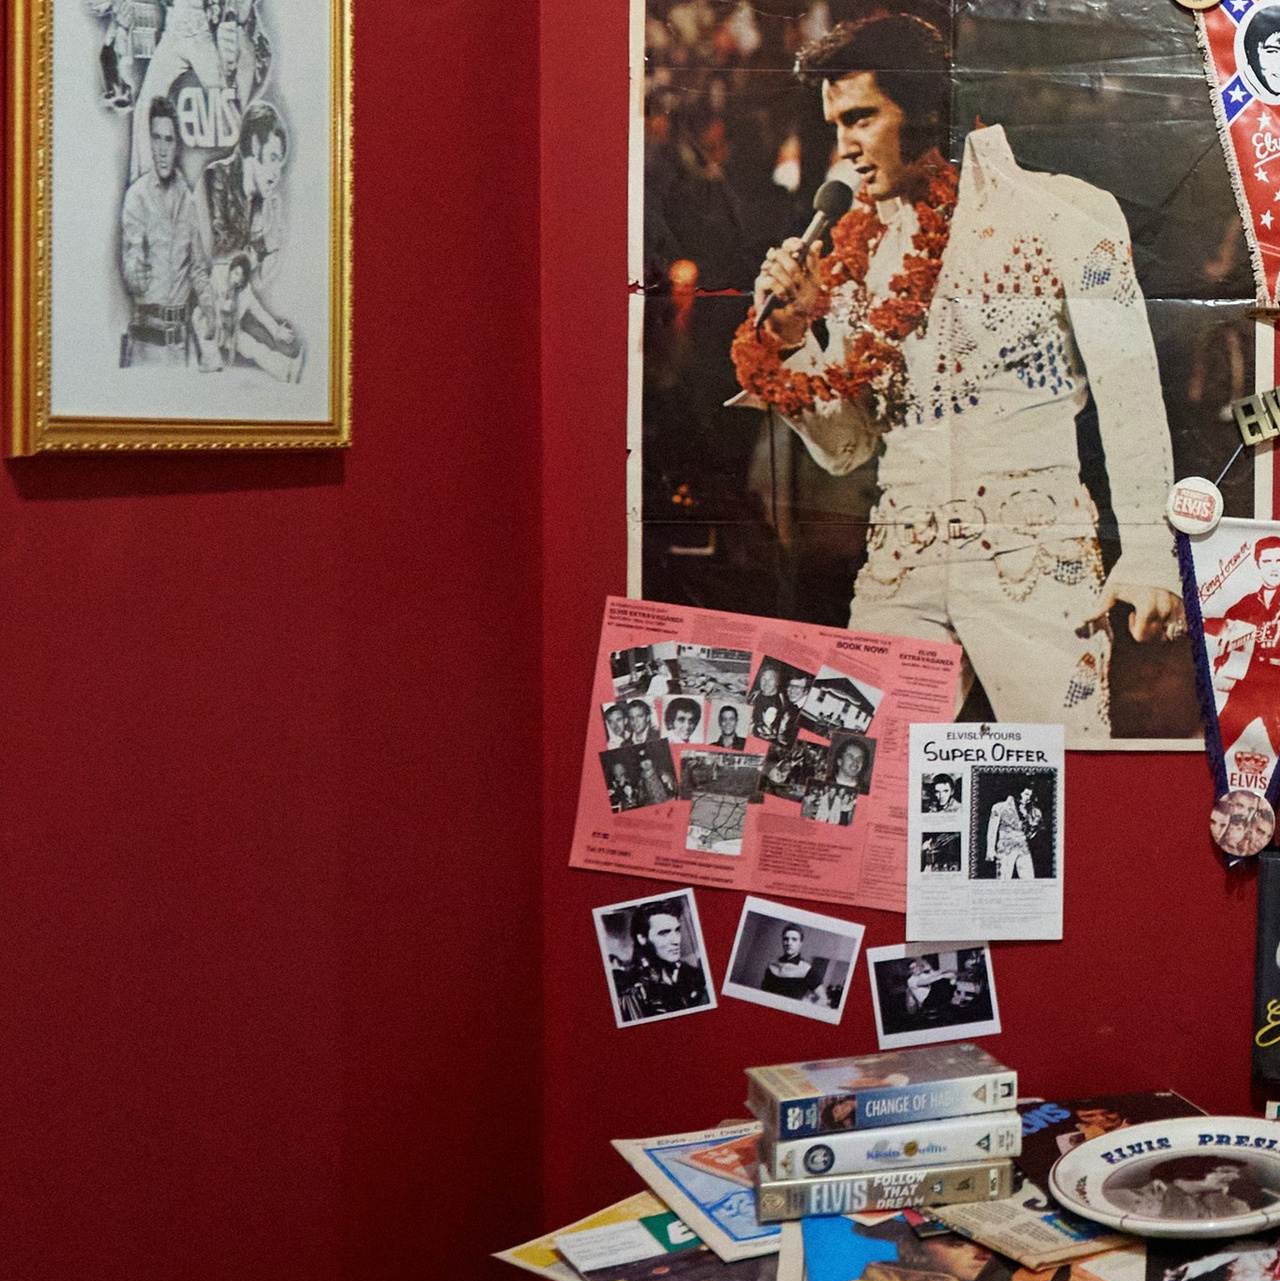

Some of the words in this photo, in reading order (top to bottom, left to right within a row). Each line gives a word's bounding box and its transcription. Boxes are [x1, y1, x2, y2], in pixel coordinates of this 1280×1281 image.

[1174, 497, 1213, 518] ELVIS
[836, 641, 862, 653] BOOK
[987, 732, 1022, 741] YOURS
[923, 741, 987, 762] SUPER
[991, 742, 1048, 763] OFFER
[1229, 772, 1267, 790] ELVIS
[865, 1097, 910, 1118] CHANGE
[912, 1094, 927, 1110] OF
[1100, 1138, 1172, 1165] ELVIS
[873, 1172, 928, 1187] FOLLOW
[810, 1180, 869, 1215] ELVIS
[882, 1184, 918, 1199] THAT
[876, 1197, 925, 1211] DREAM
